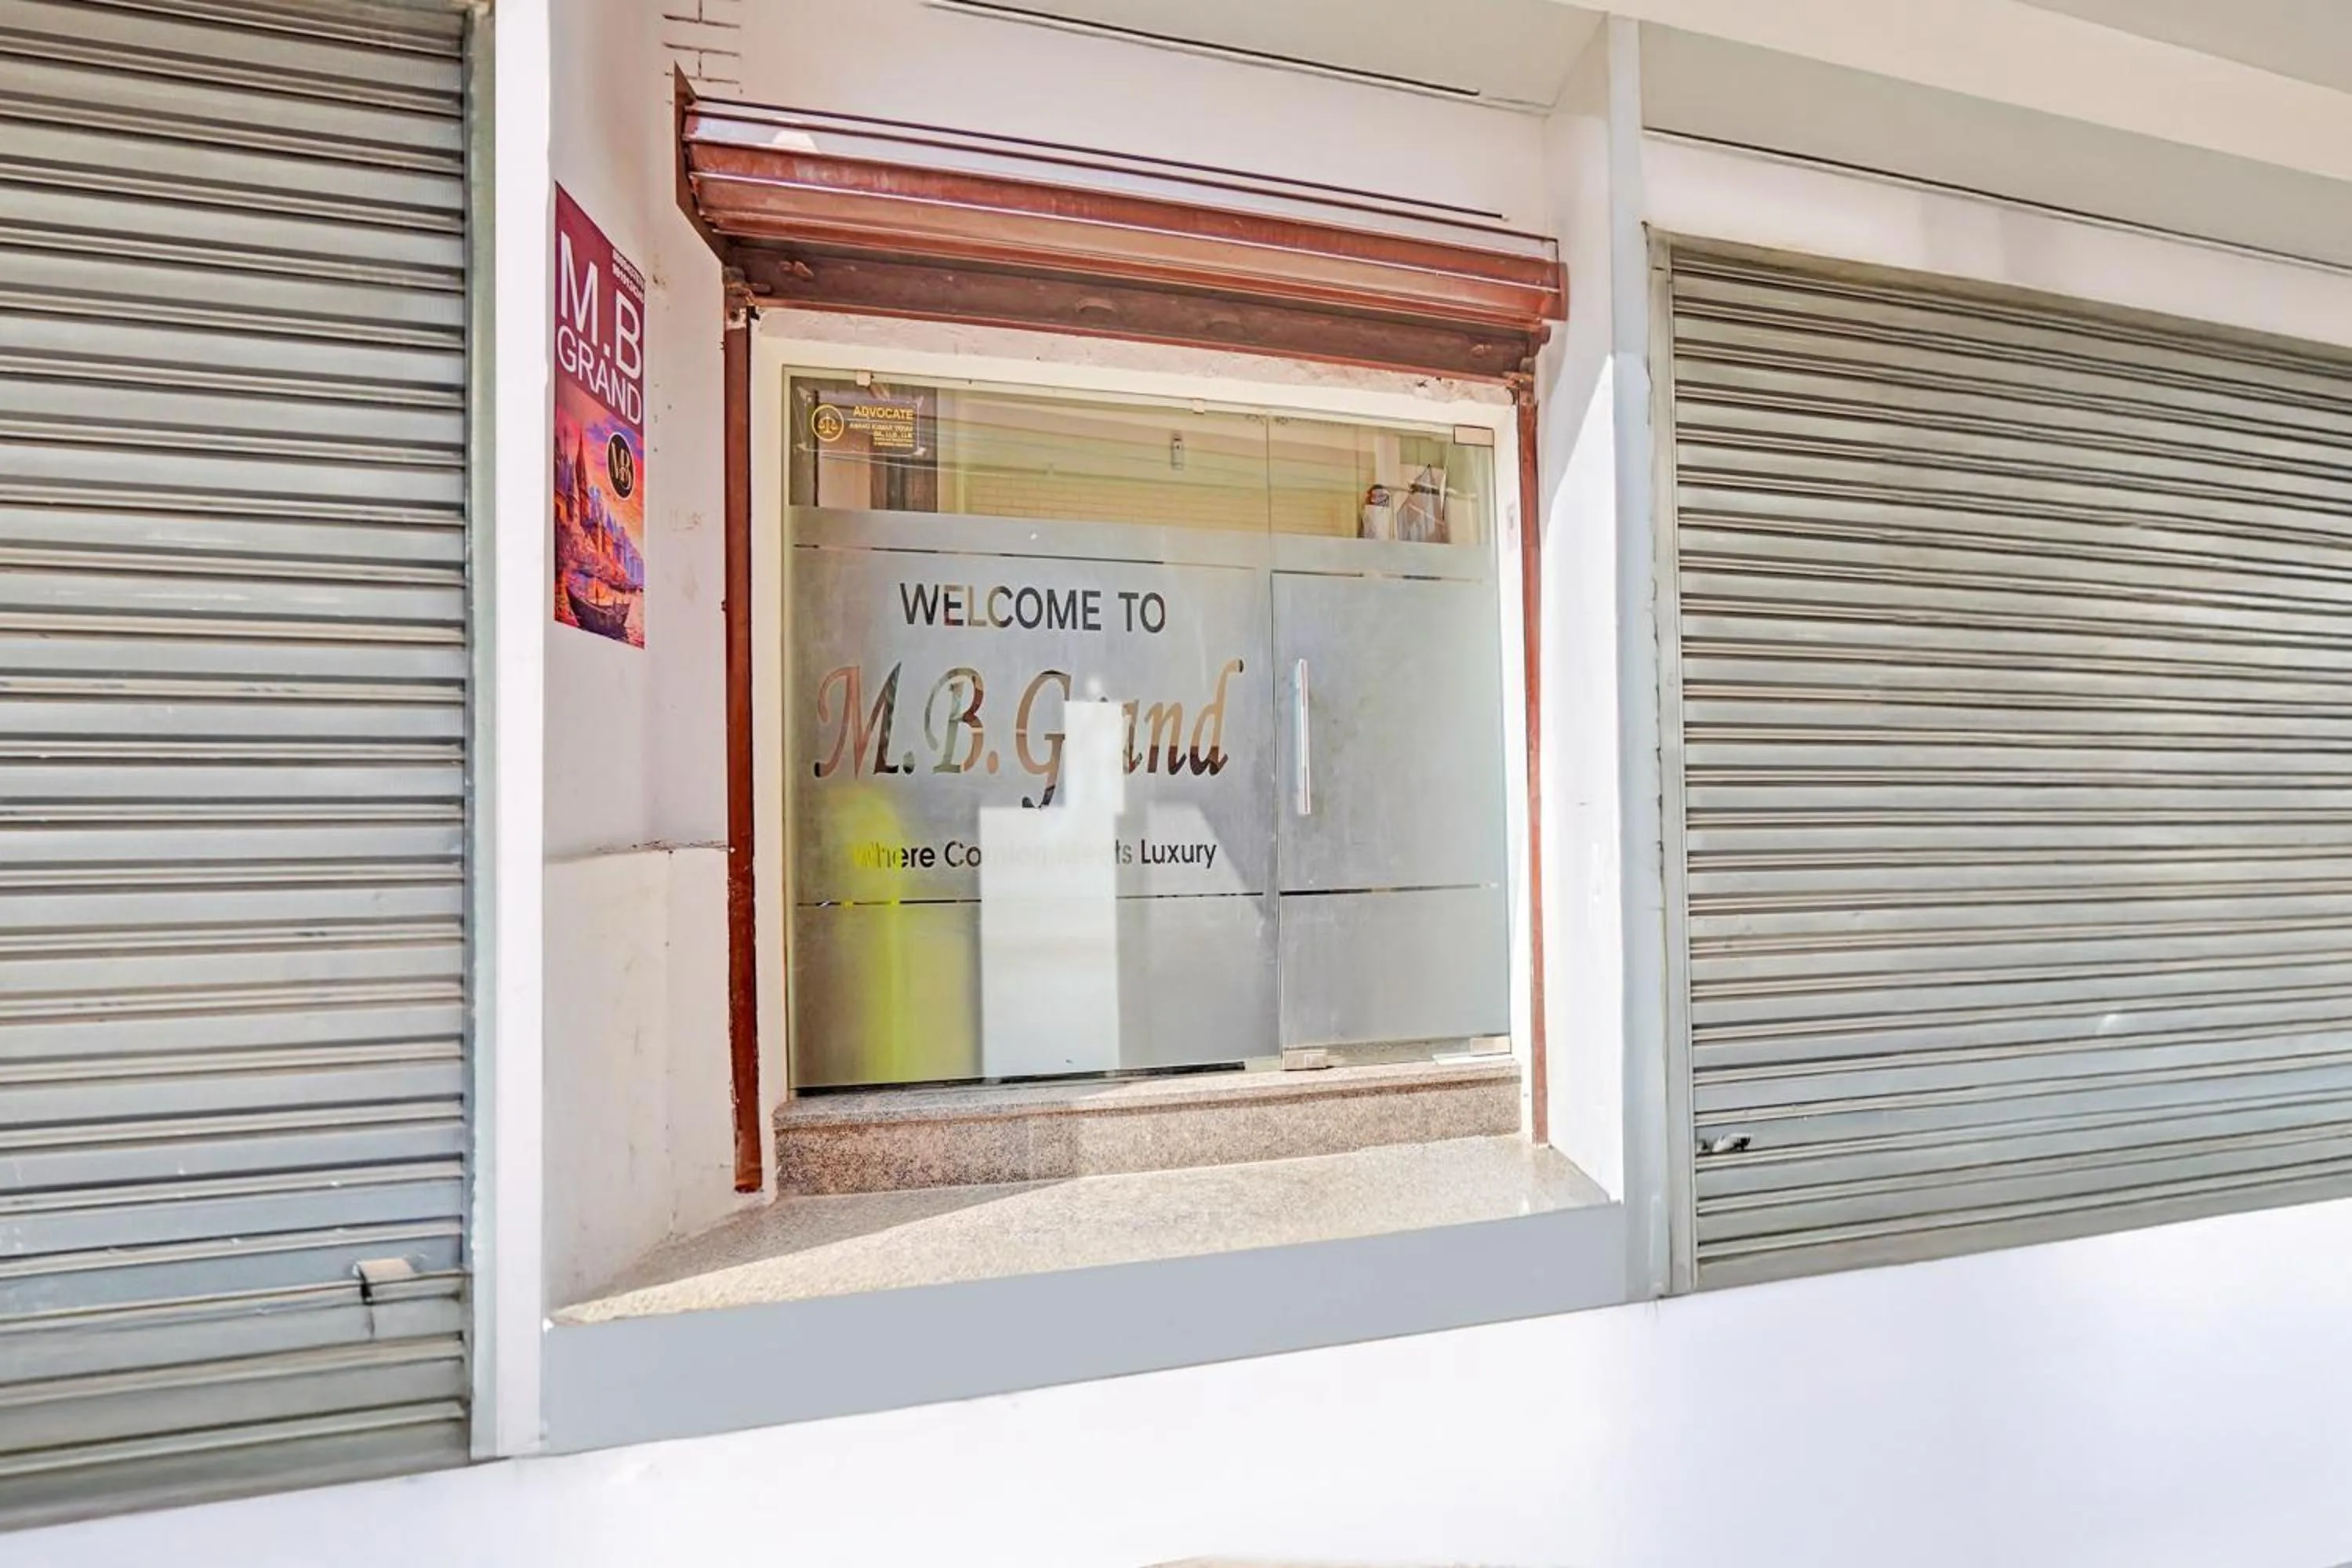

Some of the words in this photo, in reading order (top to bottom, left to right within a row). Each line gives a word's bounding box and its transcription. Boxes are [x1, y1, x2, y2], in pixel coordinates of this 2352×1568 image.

[561, 231, 642, 378] M.B
[557, 325, 642, 424] GRAND
[852, 405, 914, 420] ADVOCATE
[899, 583, 1102, 632] WELCOME
[1117, 590, 1167, 634] TO
[1140, 839, 1218, 869] Luxury
